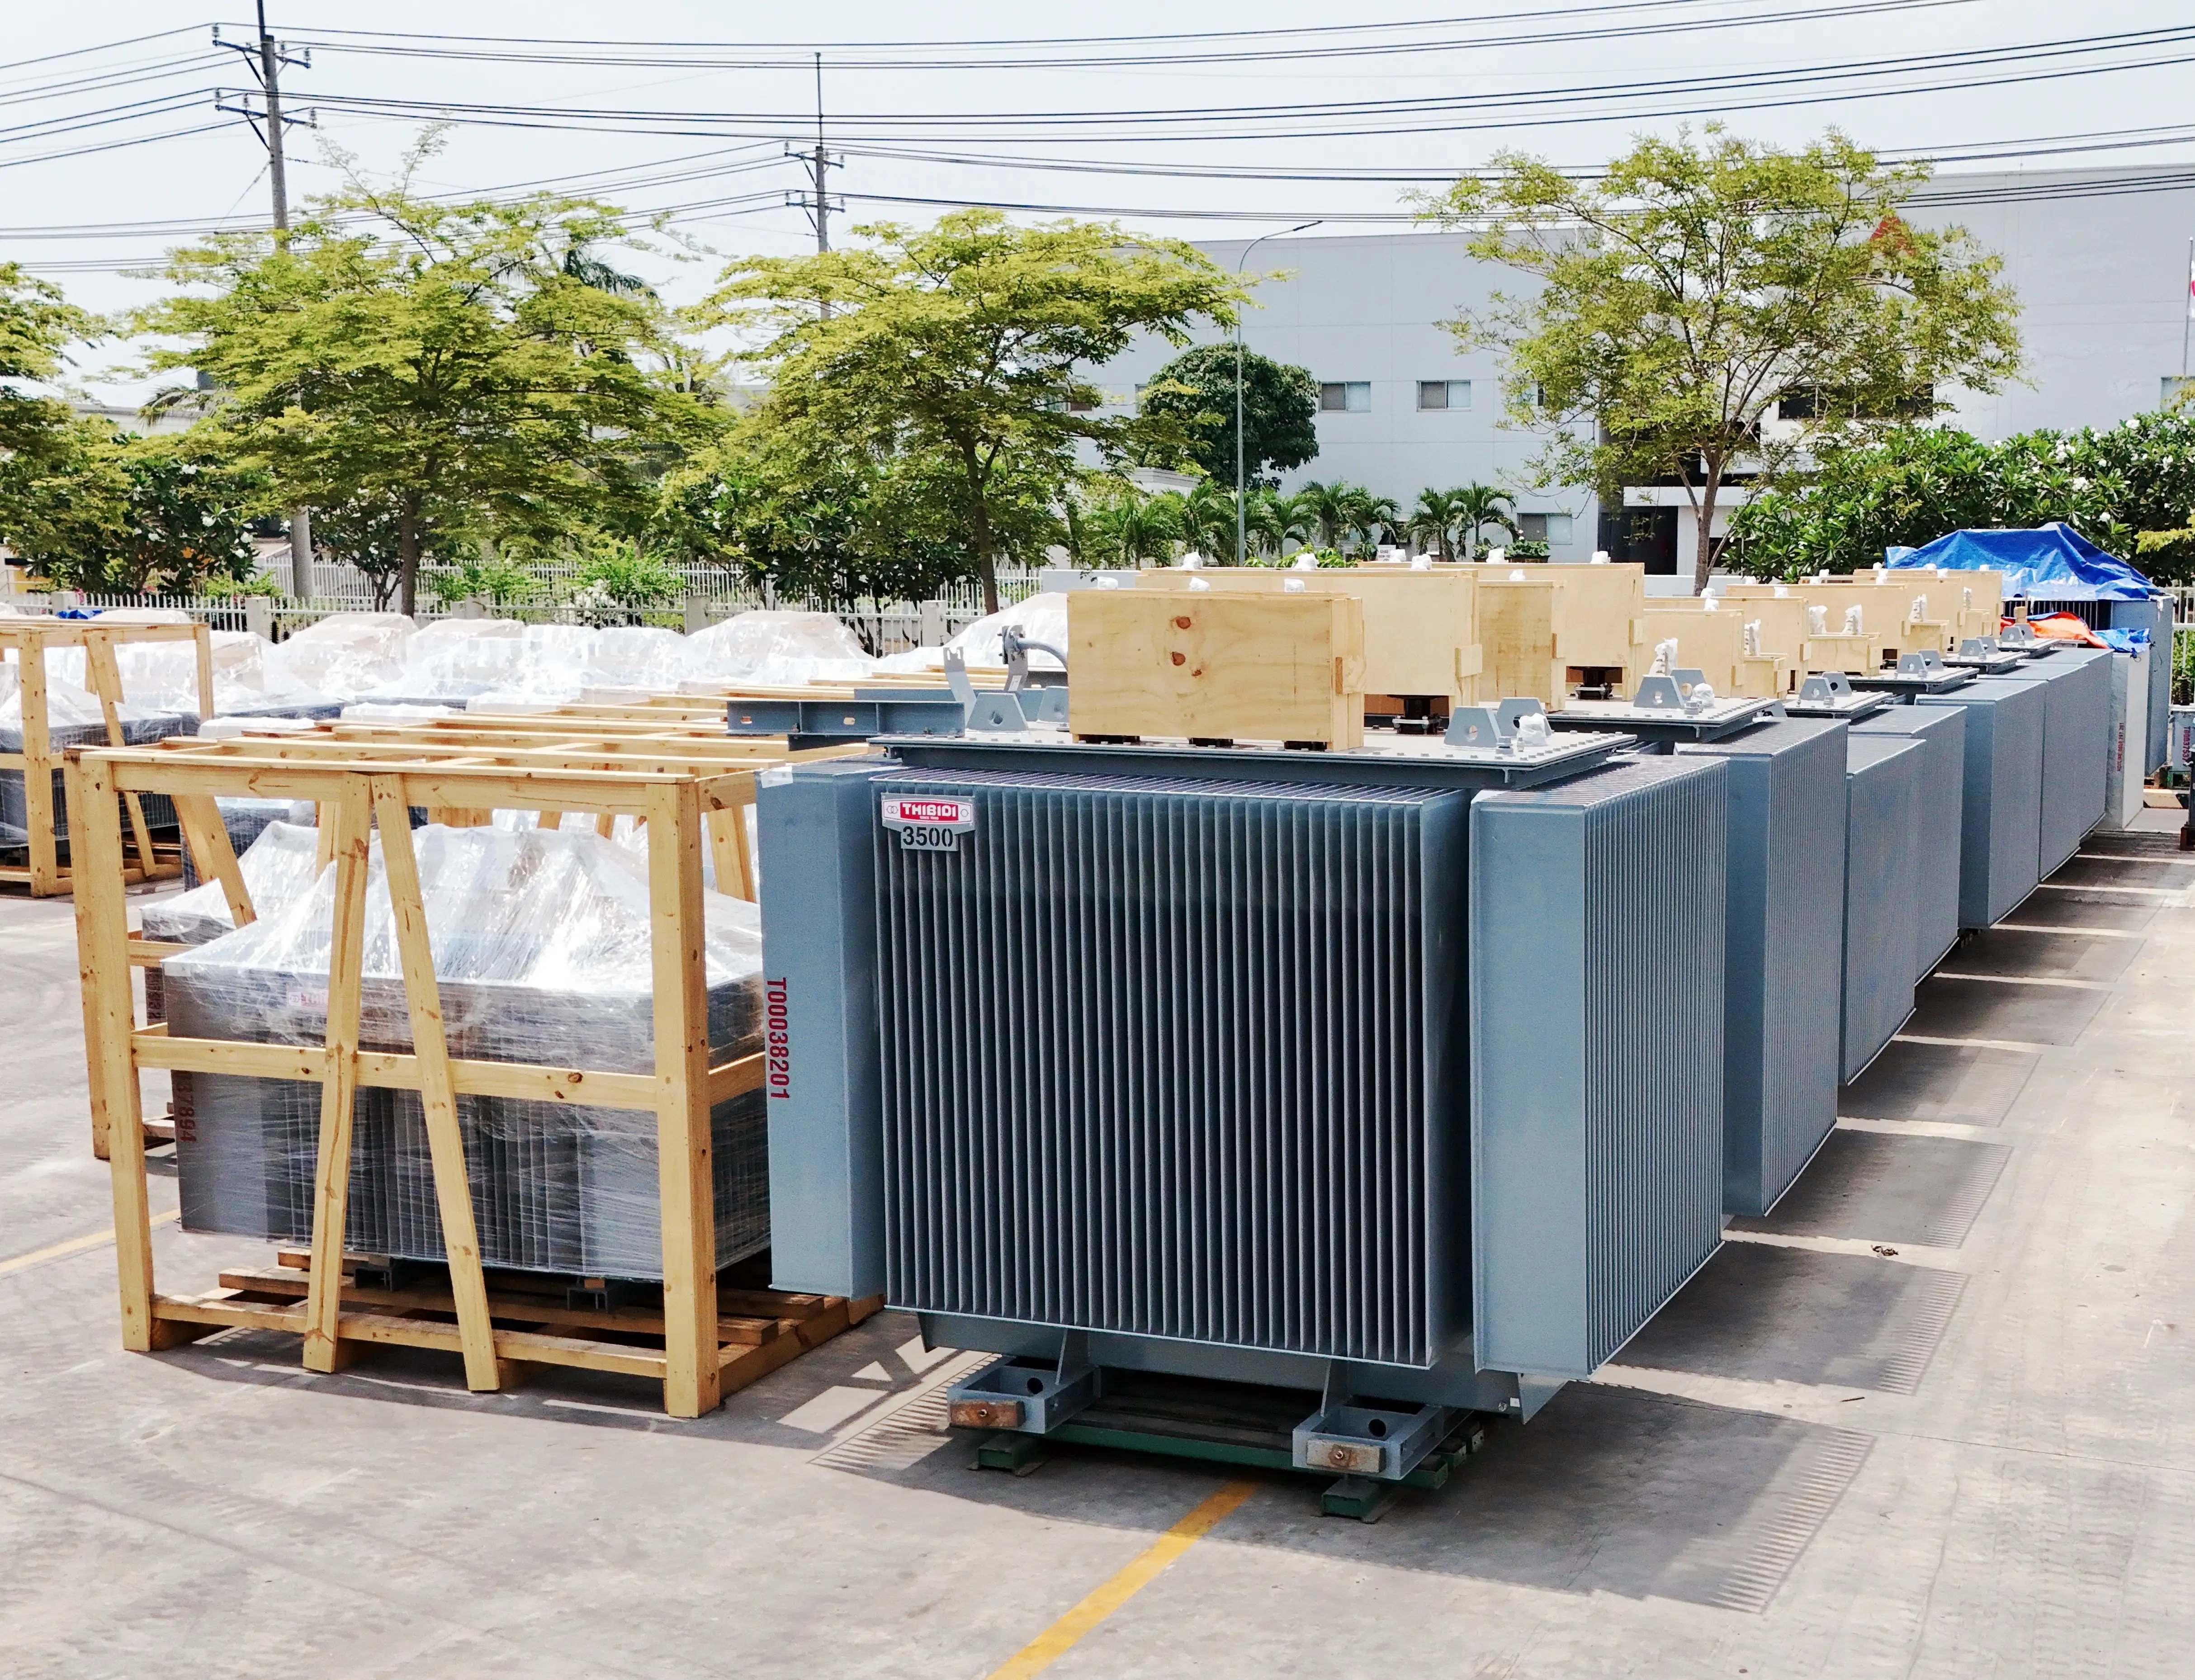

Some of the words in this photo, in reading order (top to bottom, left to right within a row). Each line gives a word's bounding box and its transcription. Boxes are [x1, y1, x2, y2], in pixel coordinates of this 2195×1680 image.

[902, 803, 956, 817] THIBIDI
[903, 826, 953, 847] 3500
[767, 977, 790, 1098] T00038201
